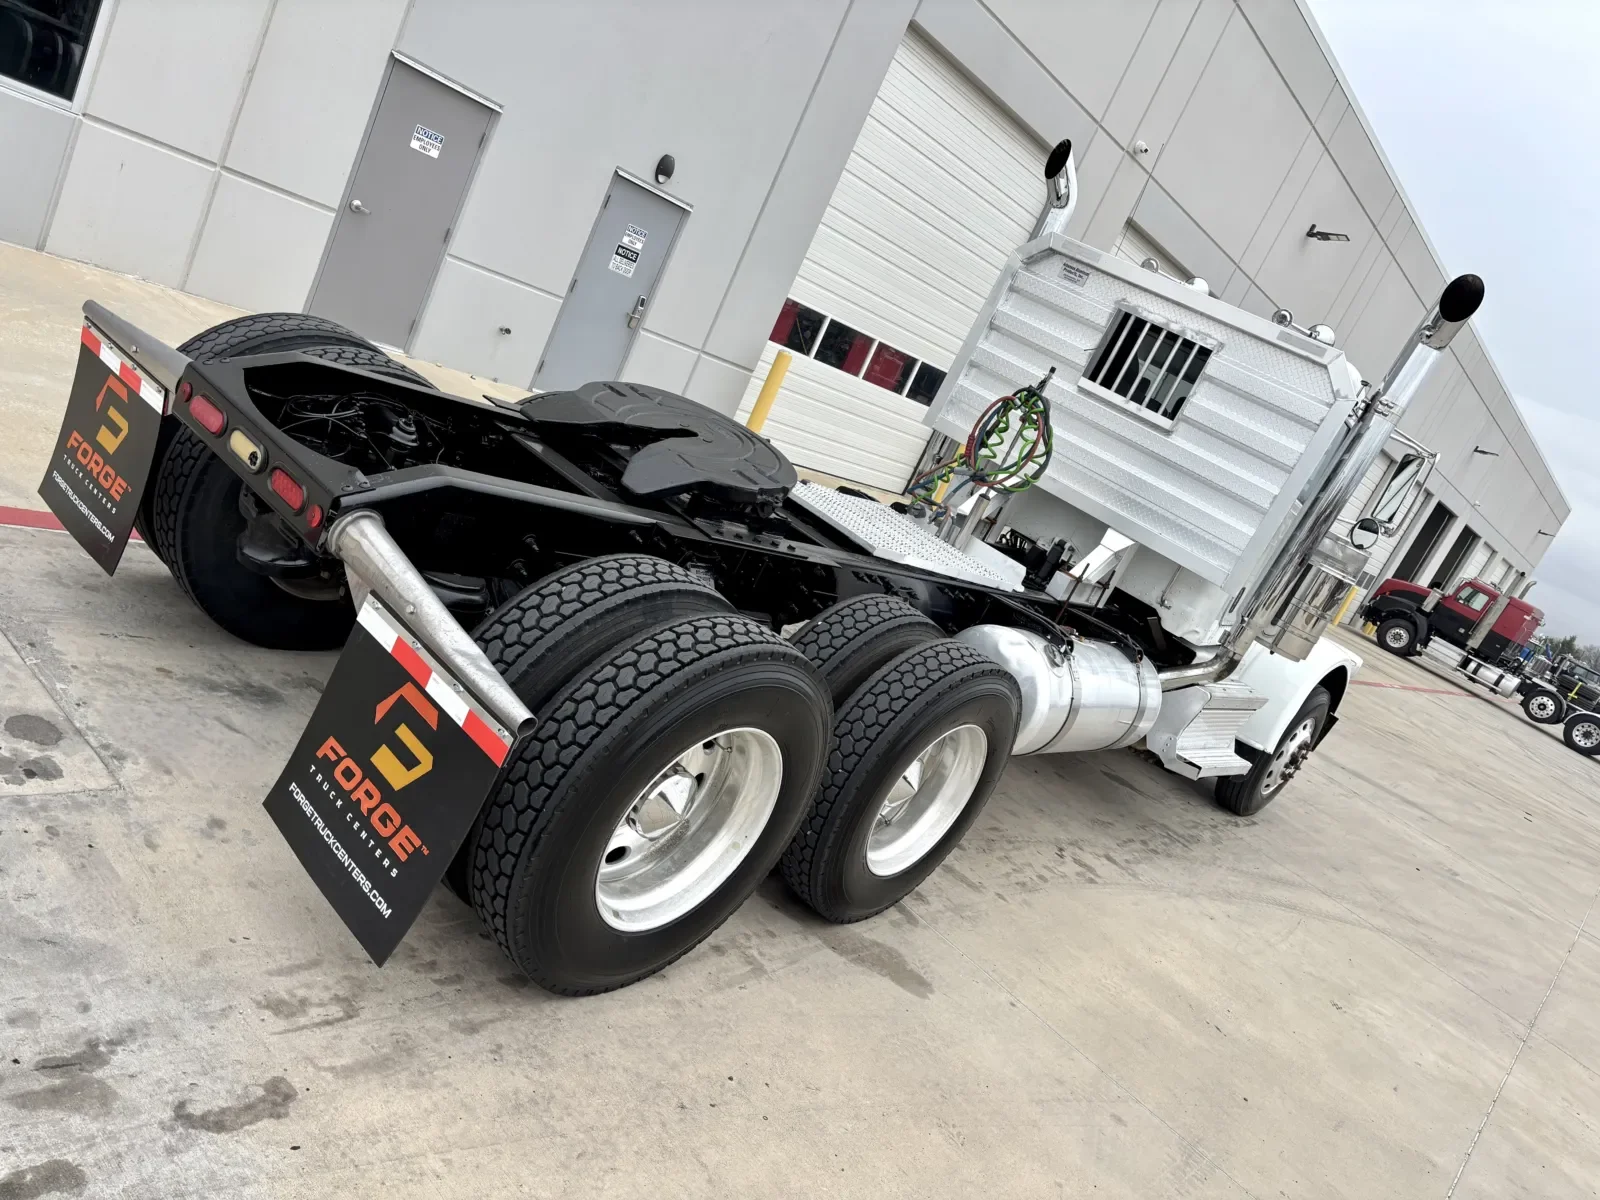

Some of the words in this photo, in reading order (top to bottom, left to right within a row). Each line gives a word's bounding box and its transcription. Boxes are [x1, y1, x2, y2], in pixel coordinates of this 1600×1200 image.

[413, 135, 440, 151] EMPLOYEES
[416, 126, 444, 144] NOTICE
[419, 144, 431, 153] ONLY
[617, 246, 637, 261] NOTICE
[627, 225, 647, 238] NOTICE
[63, 454, 83, 479] TRUCK
[85, 479, 117, 515] CENTERS
[66, 430, 127, 502] FORGE
[52, 470, 115, 543] FORGETRUCKCENTERS.COM
[309, 765, 343, 809] TRUCK
[346, 812, 398, 878] CENTERS
[315, 735, 422, 862] FORGE
[289, 782, 392, 919] FORGETRUCKCENTERS.COM
